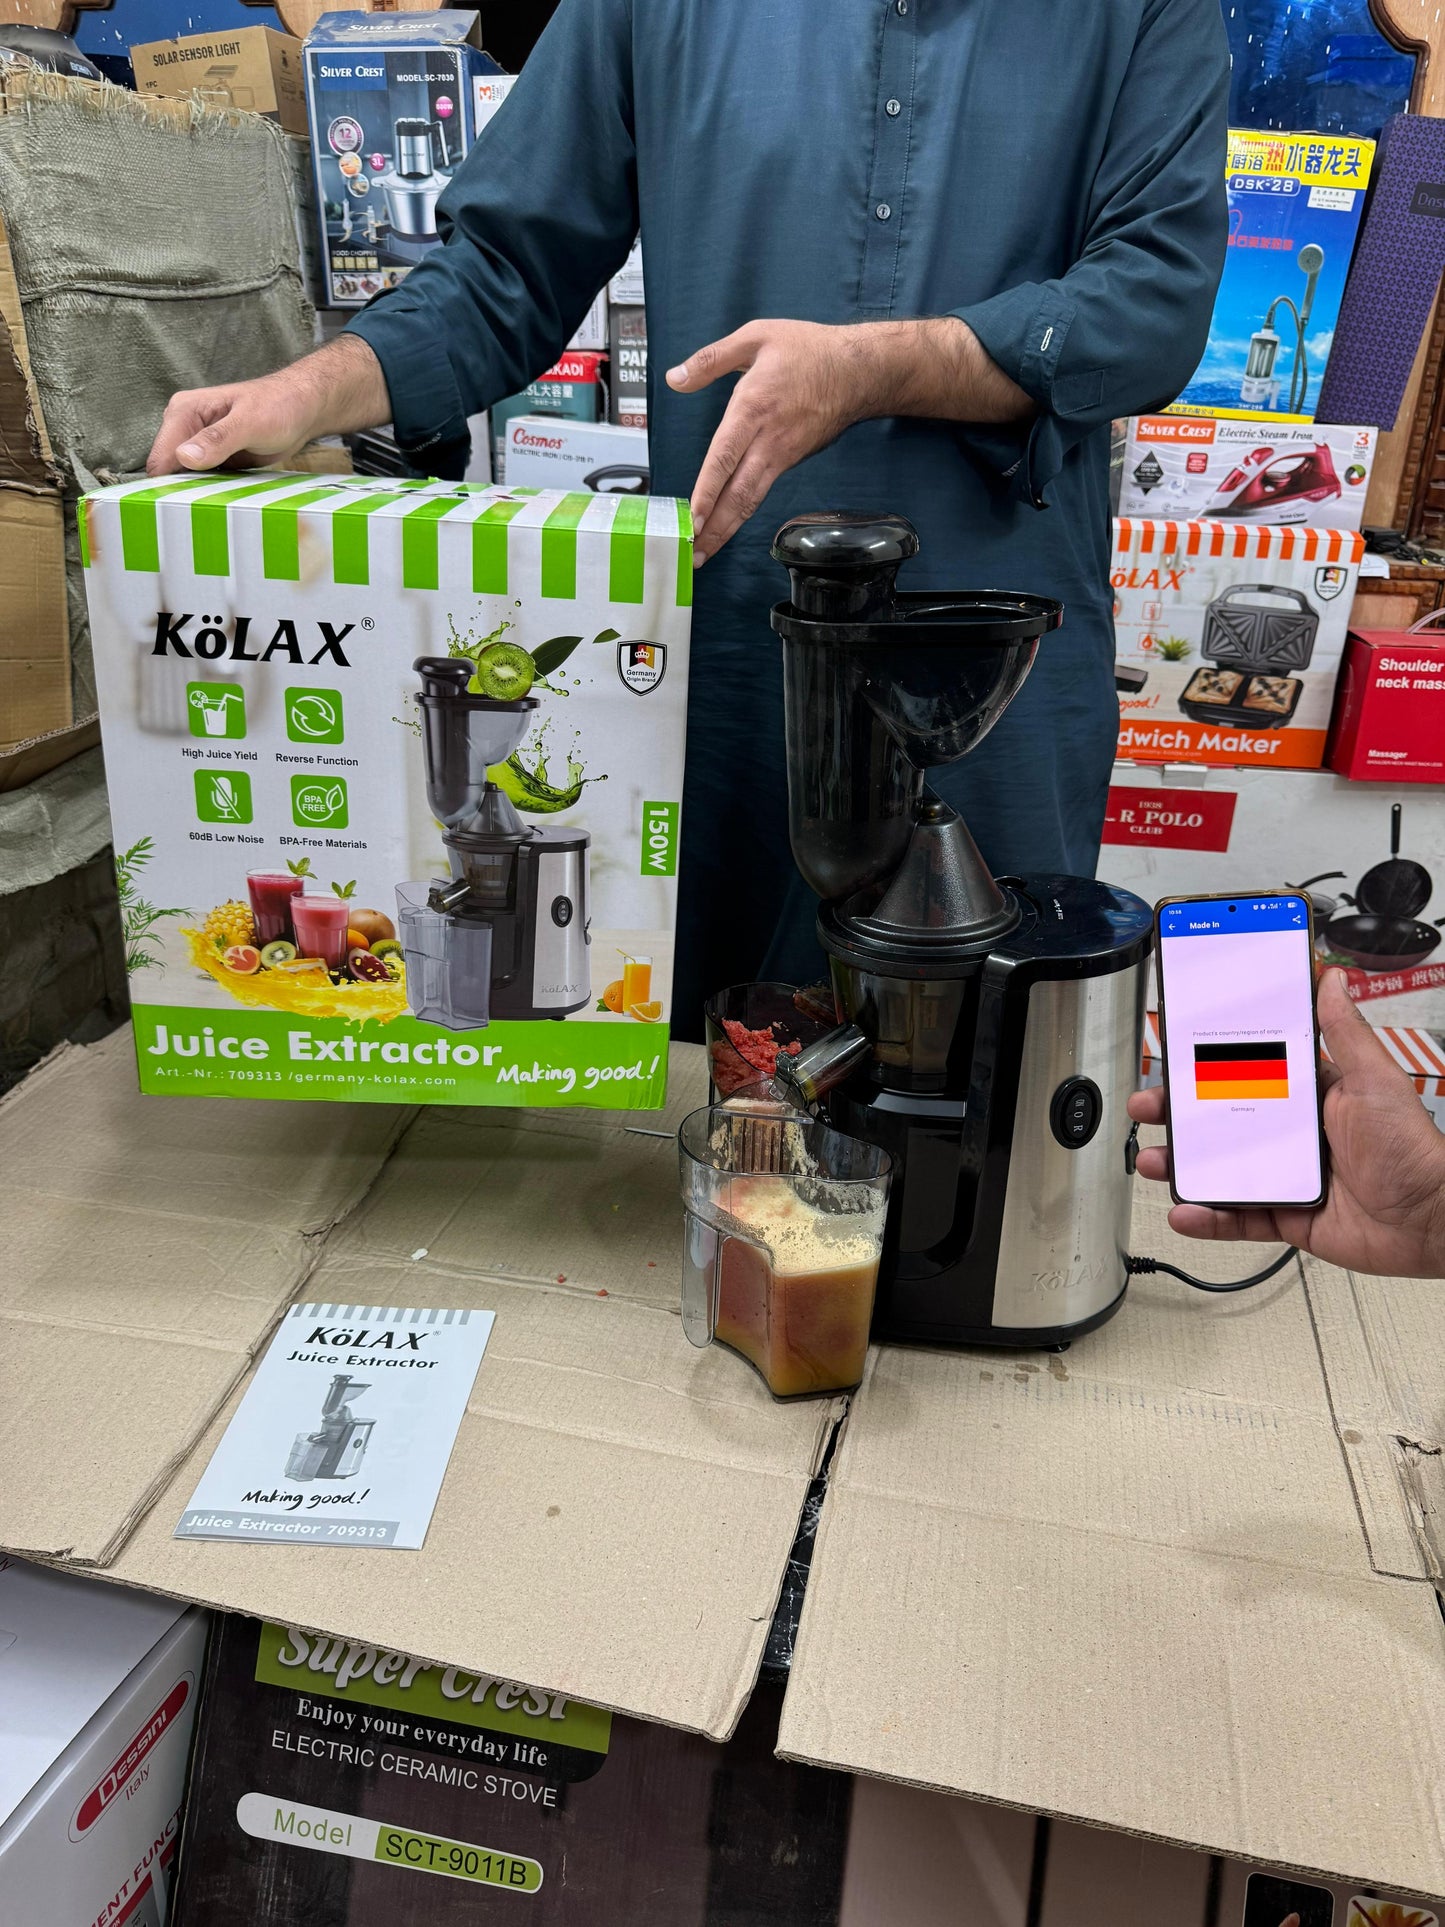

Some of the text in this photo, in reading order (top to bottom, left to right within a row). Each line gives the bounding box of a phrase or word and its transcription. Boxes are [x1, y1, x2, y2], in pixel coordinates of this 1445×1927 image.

[153, 42, 240, 67] SOLAR SENSOR LIGHT
[320, 66, 384, 78] SILVER CREST
[1234, 178, 1294, 192] DSK-28
[1139, 422, 1213, 437] SILVER CREST
[1218, 428, 1313, 440] Electric Steam Iron
[513, 427, 563, 449] Cosmos
[1355, 432, 1369, 445] 3
[1378, 658, 1444, 673] Shoulder
[626, 669, 656, 678] Germany
[1375, 676, 1410, 689] neck
[1197, 732, 1281, 754] Maker
[182, 748, 258, 761] High Juice Yield
[276, 753, 358, 766] Reverse Function
[1368, 750, 1408, 759] Massager
[304, 795, 322, 803] BPA
[302, 804, 326, 812] FREE
[1144, 811, 1203, 827] POLO
[189, 832, 264, 844] 60dB Low Noise
[1130, 826, 1162, 835] CLUB
[279, 837, 368, 849] BPA-Free Materials
[648, 807, 669, 871] 150W
[148, 1024, 503, 1066] Juice Extractor
[229, 1070, 282, 1081] 709313
[496, 1054, 660, 1093] Making good!
[286, 1350, 439, 1369] Juice Extractor
[241, 1488, 371, 1510] Making good!
[186, 1515, 387, 1538] Juice Extractor 709313
[277, 1628, 434, 1688] Super
[296, 1698, 549, 1767] Enjoy your everyday life
[271, 1730, 558, 1808] ELECTRIC CERAMIC STOVE
[126, 1763, 150, 1800] Italy
[274, 1808, 527, 1886] Model SCT-9011B
